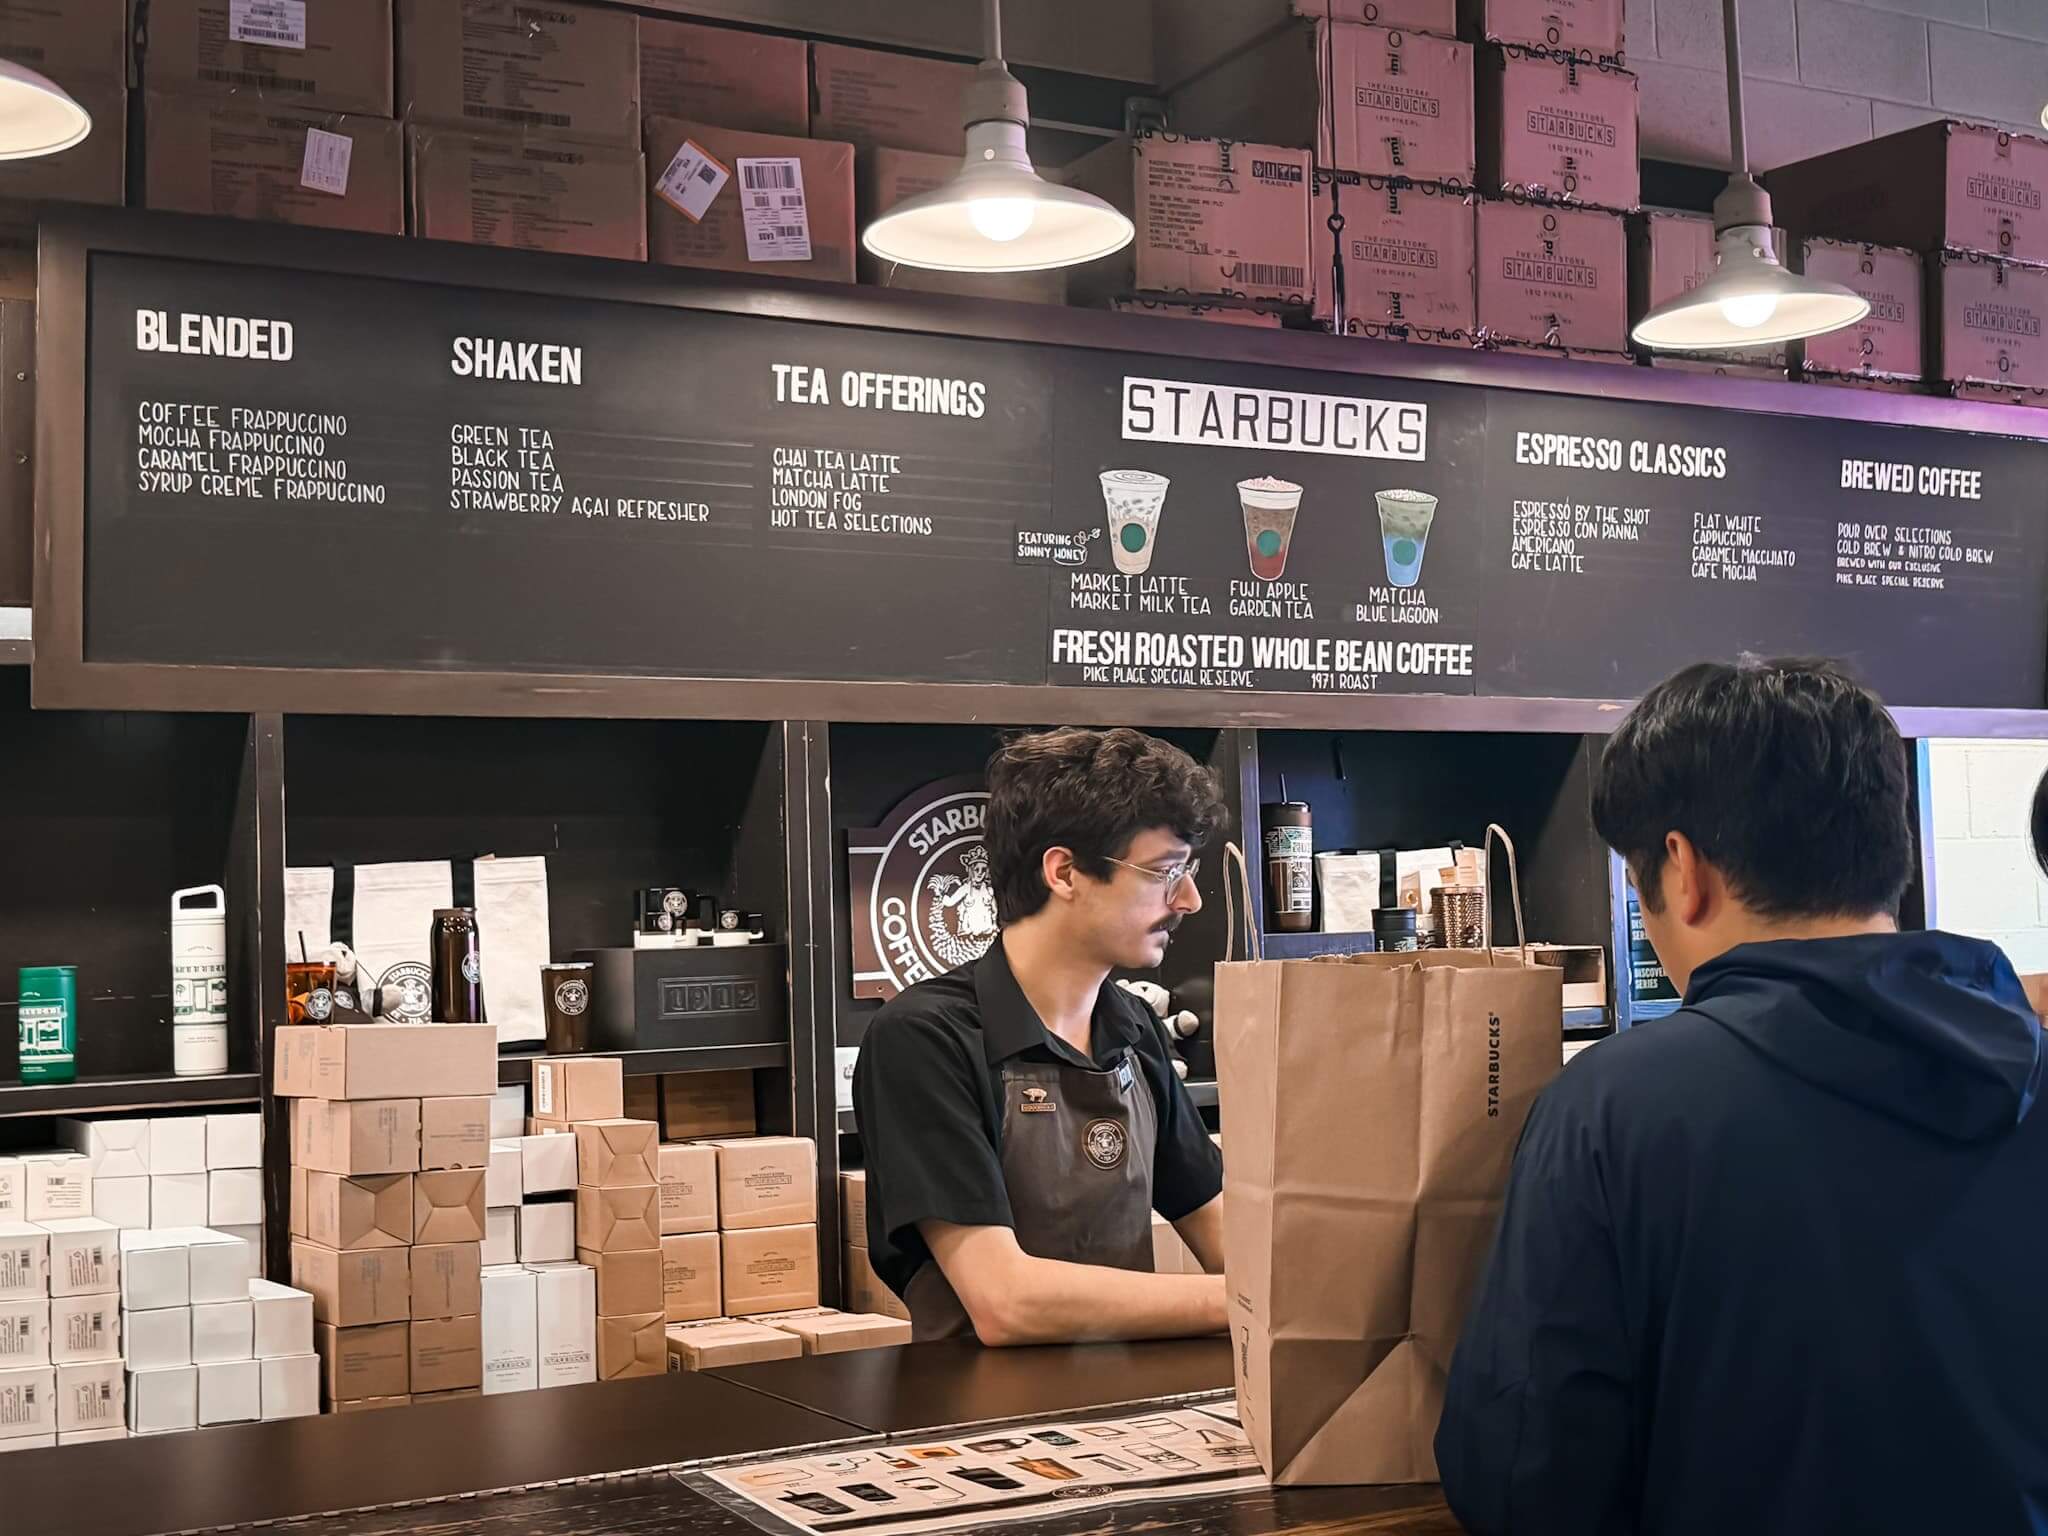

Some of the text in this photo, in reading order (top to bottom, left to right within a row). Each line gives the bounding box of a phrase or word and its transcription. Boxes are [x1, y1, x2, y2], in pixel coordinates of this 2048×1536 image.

[1358, 91, 1437, 114] STARBUCKS
[1529, 115, 1614, 143] STARBUCKS
[1354, 244, 1436, 265] STARBUCKS
[1505, 262, 1595, 285] STARBUCKS
[136, 309, 293, 361] BLENDED
[451, 336, 582, 385] SHAKEN
[772, 364, 986, 418] TEA OFFERINGS
[139, 401, 347, 436] COFFEE FRAPPUCCINO
[1128, 384, 1423, 454] STARBUCKS
[139, 425, 325, 457] MOCHA FRAPPUCCINO
[451, 424, 554, 450] GREEN TEA
[138, 448, 347, 480] CARAMEL FRAPPUCCINO
[452, 446, 555, 471] BLACK TEA
[773, 448, 901, 474] CHAI TEA LATTE
[1516, 431, 1728, 479] ESPRESSO CLASSICS
[138, 471, 386, 504] SYRUP CREME FRAPPUCCINO
[452, 467, 564, 493] PASSION TEA
[773, 468, 890, 493] MATCHA LATTE
[1841, 459, 1982, 500] BREWED COFFEE
[450, 489, 710, 522] STRAWBERRY AÇAI REFRESHER
[773, 488, 862, 511] LONDON FOG
[771, 510, 932, 535] HOT TEA SELECTIONS
[1513, 500, 1650, 525] ESPRESSO BY THE SHOT
[1694, 512, 1762, 533] FLAT WHITE
[1018, 531, 1072, 546] FEATURING
[1513, 517, 1639, 541] ESPRESSO CON PANNA
[1693, 529, 1752, 547] CAPPUCCINO
[1838, 522, 1952, 545] POUR OVER SELECTIONS
[1018, 545, 1086, 562] SUNNY HONEY
[1512, 536, 1574, 554] AMERICANO
[1692, 546, 1796, 567] CARAMEL MACCHIATO
[1837, 539, 1860, 555] COLD
[1864, 541, 1892, 557] BREW
[1908, 545, 1936, 560] NITRO
[1938, 546, 1962, 562] COLD
[1965, 548, 1994, 564] BREW
[1511, 552, 1584, 573] CAFE LATTE
[1692, 562, 1757, 581] CAFE MOCHA
[1837, 556, 1942, 573] BREWED WITH OUR EXCLUSIVE
[1071, 572, 1191, 595] MARKET LATTE
[1230, 580, 1309, 601] FUJI APPLE
[1836, 572, 1945, 590] PIKE PLACE SPECIAL RESERVE
[1071, 592, 1211, 616] MARKET MILK TEA
[1369, 586, 1426, 606] MATCHA
[1230, 599, 1314, 620] GARDEN TEA
[1356, 604, 1439, 624] BLUE LAGOON
[1052, 629, 1473, 676] FRESH ROASTED WHOLE BEAN COFFEE
[1083, 667, 1254, 688] PIKE PLACE SPECIAL RESERVE
[1311, 673, 1378, 690] 1971 ROAST
[882, 896, 936, 985] COFFE
[1635, 978, 1659, 990] SERIES
[1488, 1016, 1500, 1117] STARBUCKS
